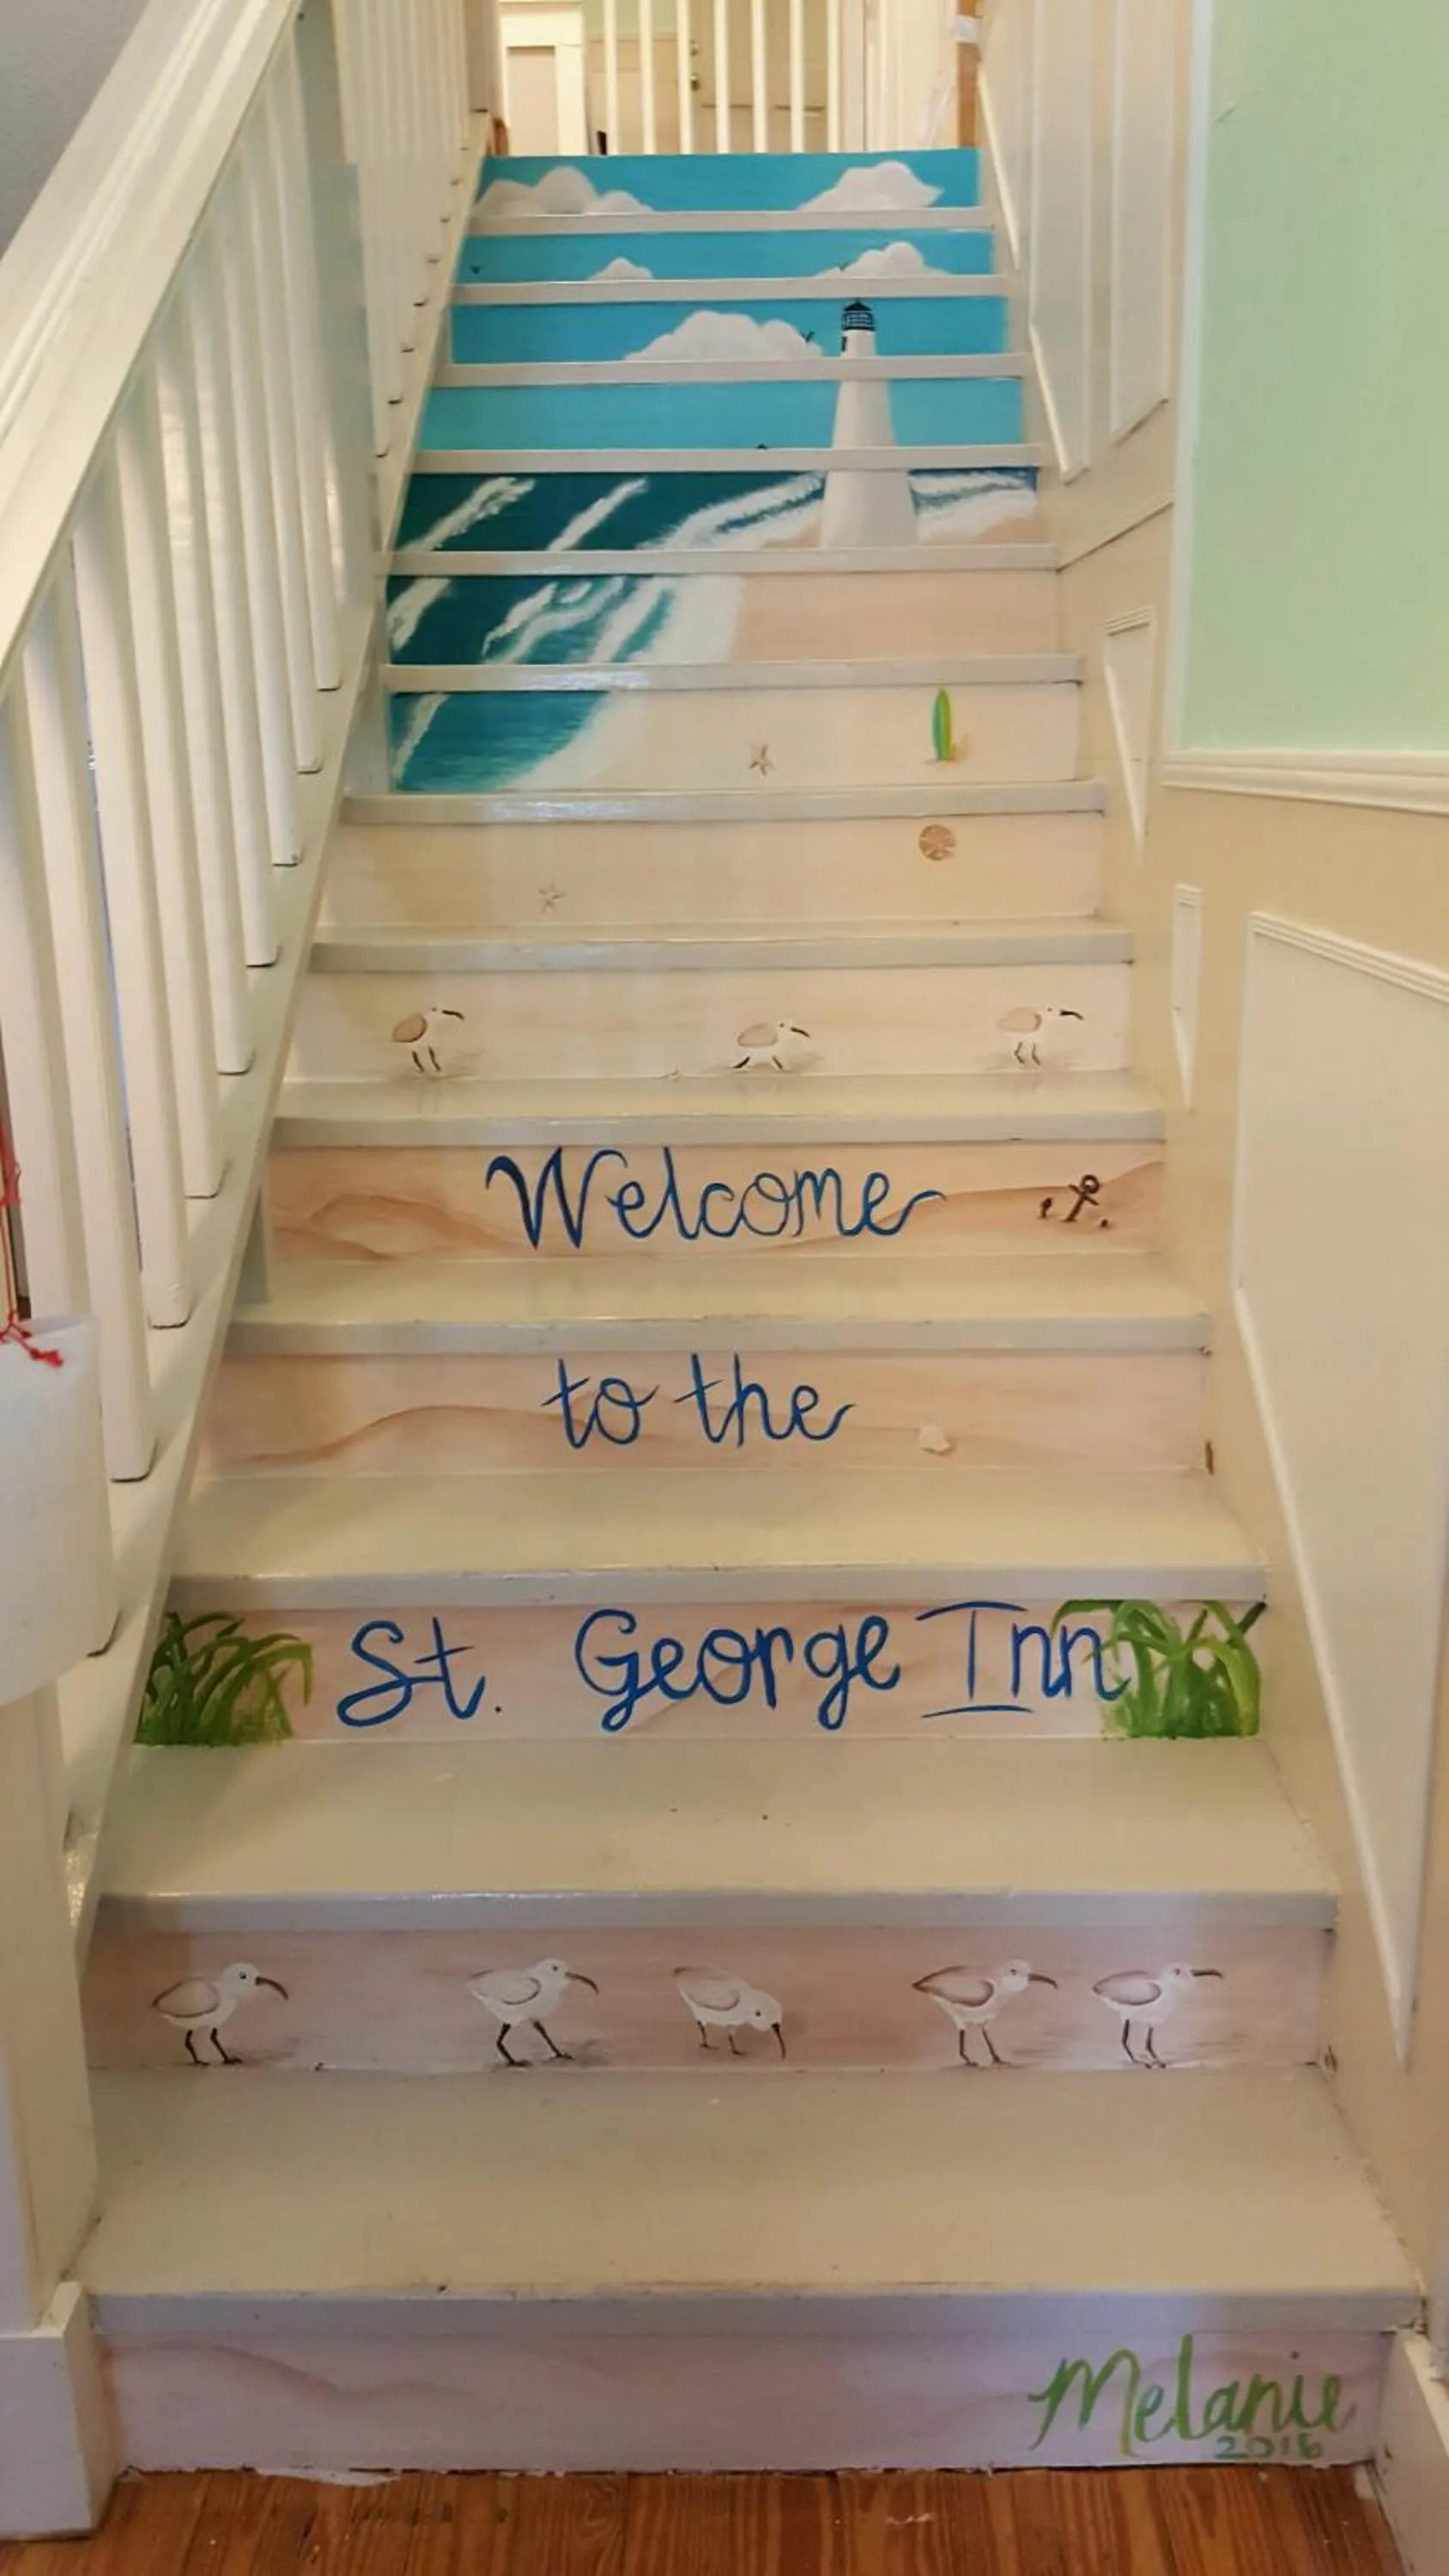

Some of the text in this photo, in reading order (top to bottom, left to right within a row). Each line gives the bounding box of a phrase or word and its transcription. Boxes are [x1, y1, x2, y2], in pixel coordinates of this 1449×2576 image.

[486, 1146, 946, 1248] Welcome
[543, 1353, 856, 1448] to the
[336, 1601, 1131, 1731] St. George Inn
[1028, 2334, 1356, 2457] Melanie
[1214, 2433, 1324, 2459] 2016
